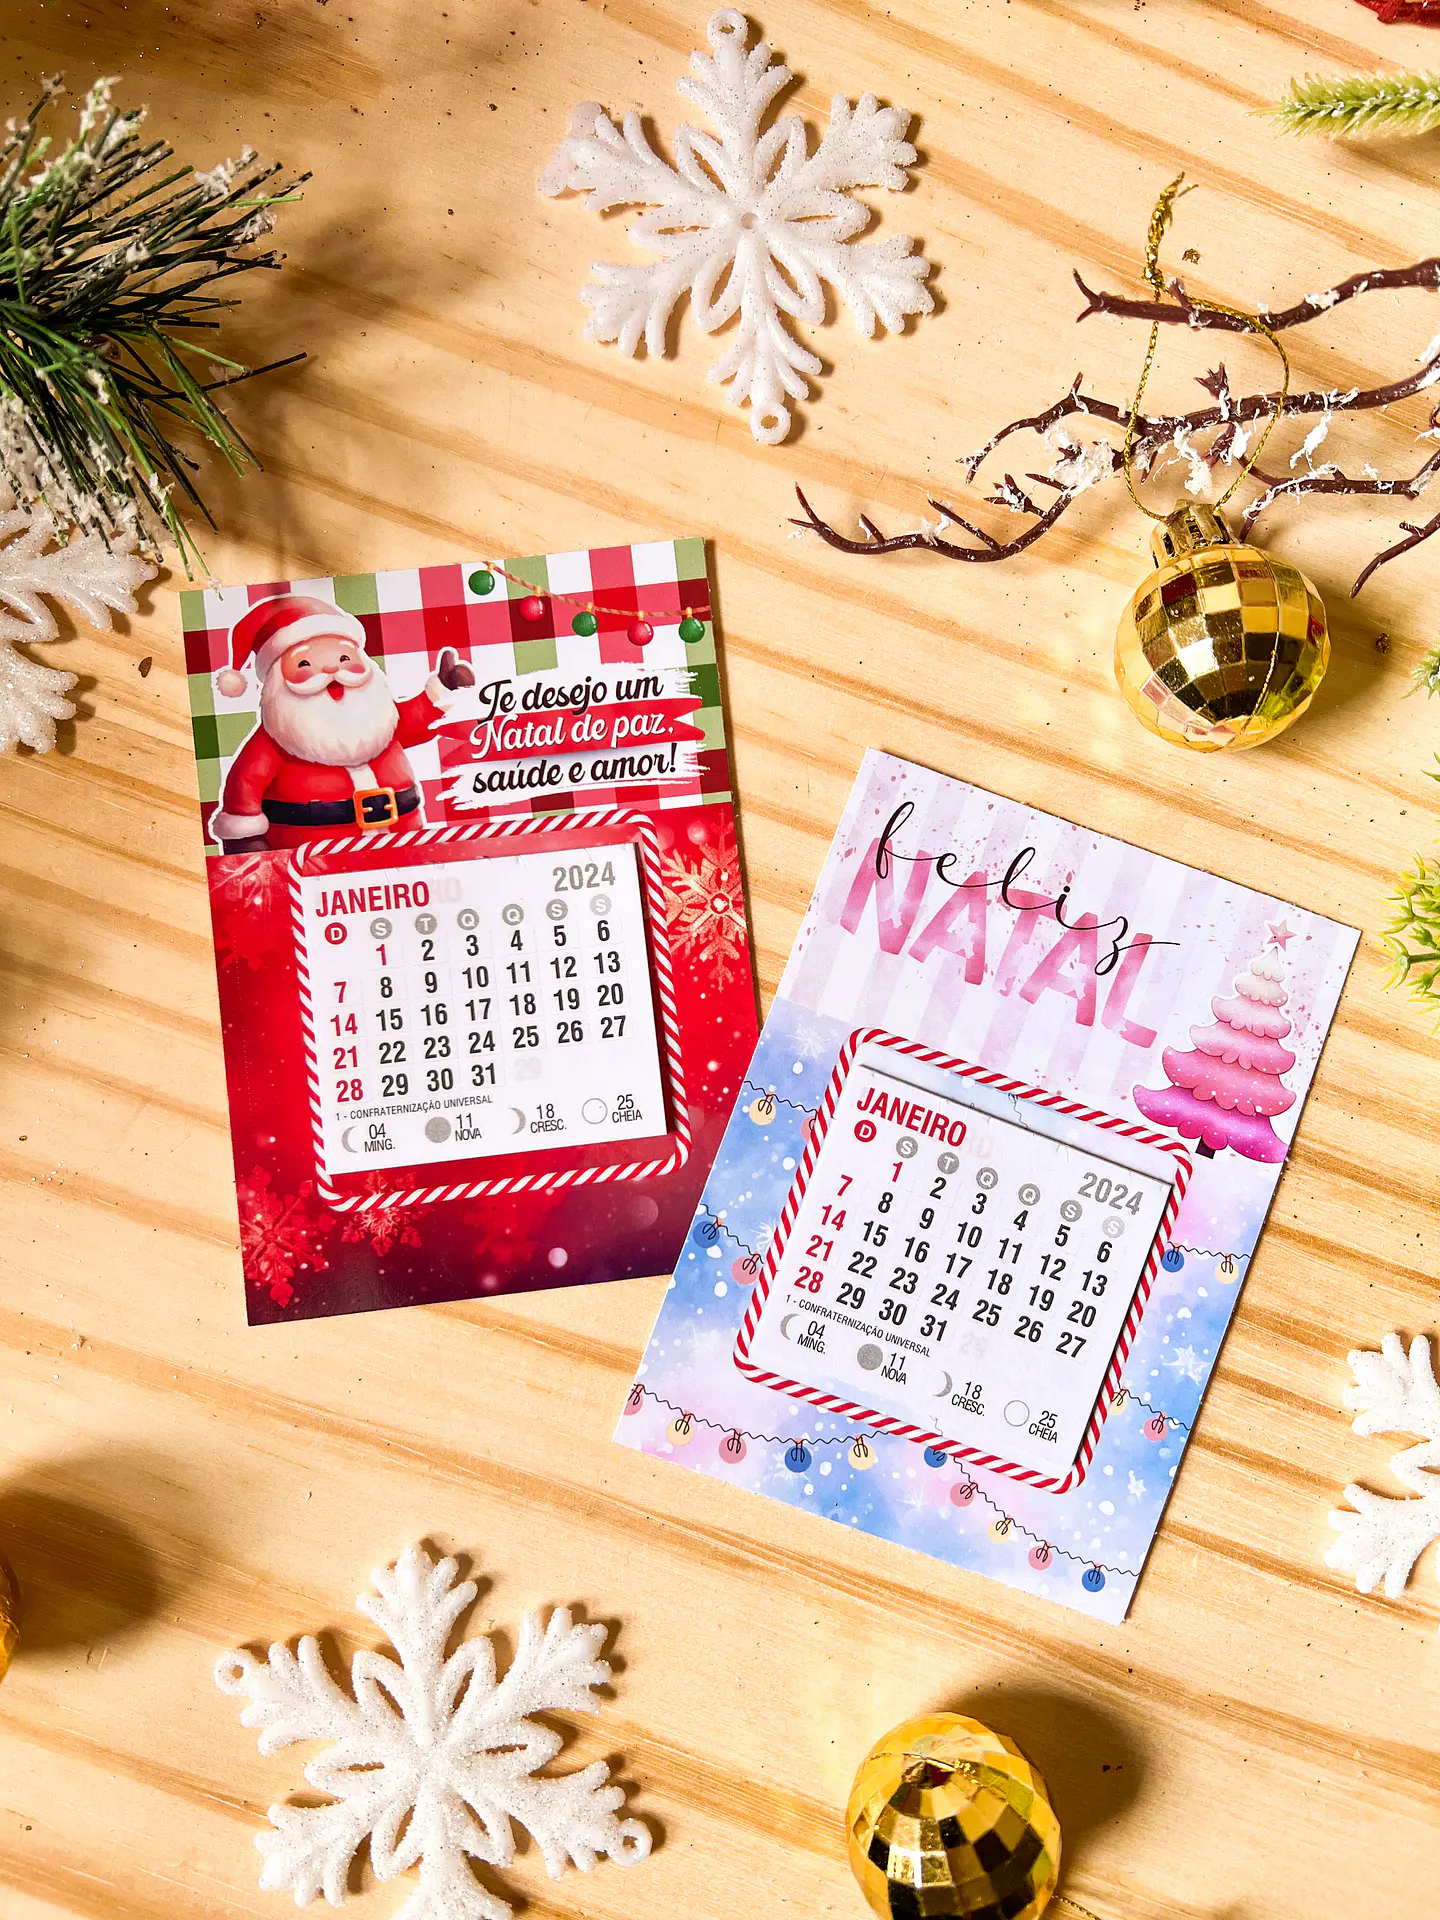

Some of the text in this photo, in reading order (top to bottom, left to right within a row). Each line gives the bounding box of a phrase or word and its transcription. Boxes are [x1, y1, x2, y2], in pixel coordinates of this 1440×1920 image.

[477, 675, 664, 723] Te desejo um
[469, 713, 565, 760] Natal
[571, 715, 608, 744] de
[472, 742, 678, 793] saúde e amor!
[552, 861, 616, 892] 2024
[876, 801, 1181, 976] feliz
[316, 881, 430, 918] JANEIRO
[376, 920, 610, 966] 1 2 3 4 5 6
[840, 837, 1158, 1049] NATAL
[334, 951, 621, 1003] 7 8 9 10 11 12 13
[330, 983, 624, 1037] 14 15 16 17 18 19 20
[333, 1015, 626, 1070] 21 22 23 24 25 26 27
[336, 1078, 364, 1103] 28
[381, 1073, 409, 1097] 29
[426, 1068, 454, 1092] 30
[471, 1063, 496, 1087] 31
[336, 1112, 340, 1121] 1
[350, 1099, 441, 1120] CONFRATERNIZAÇÃO
[443, 1095, 493, 1109] UNIVERSAL
[456, 1113, 473, 1129] 11
[536, 1103, 555, 1120] 18
[611, 1109, 643, 1124] CHEIA
[617, 1094, 634, 1111] 25
[856, 1087, 967, 1147] JANEIRO
[369, 1123, 386, 1140] 04
[454, 1127, 482, 1142] NOVA
[530, 1118, 567, 1134] CRESC.
[364, 1138, 396, 1153] MING.
[892, 1161, 1113, 1263] 1 2 3 4 5 6
[1078, 1171, 1144, 1216] 2024
[837, 1174, 1108, 1296] 7 8 9 10 11 12 13
[821, 1204, 1097, 1328] 14 15 16 17 18 19 20
[794, 1266, 948, 1342] 28 29 30 31
[805, 1234, 1087, 1358] 21 22 23 24 25 26 27
[786, 1294, 791, 1303] 1
[799, 1299, 884, 1340] CONFRATERNIZAÇÃO
[885, 1332, 931, 1357] UNIVERSAL
[797, 1333, 826, 1355] MING.
[807, 1321, 826, 1339] 04
[881, 1365, 907, 1385] NOVA
[889, 1352, 906, 1371] 11
[951, 1394, 985, 1417] CRESC.
[964, 1381, 983, 1400] 18
[1028, 1422, 1058, 1444] CHEIA
[1038, 1410, 1058, 1429] 25
